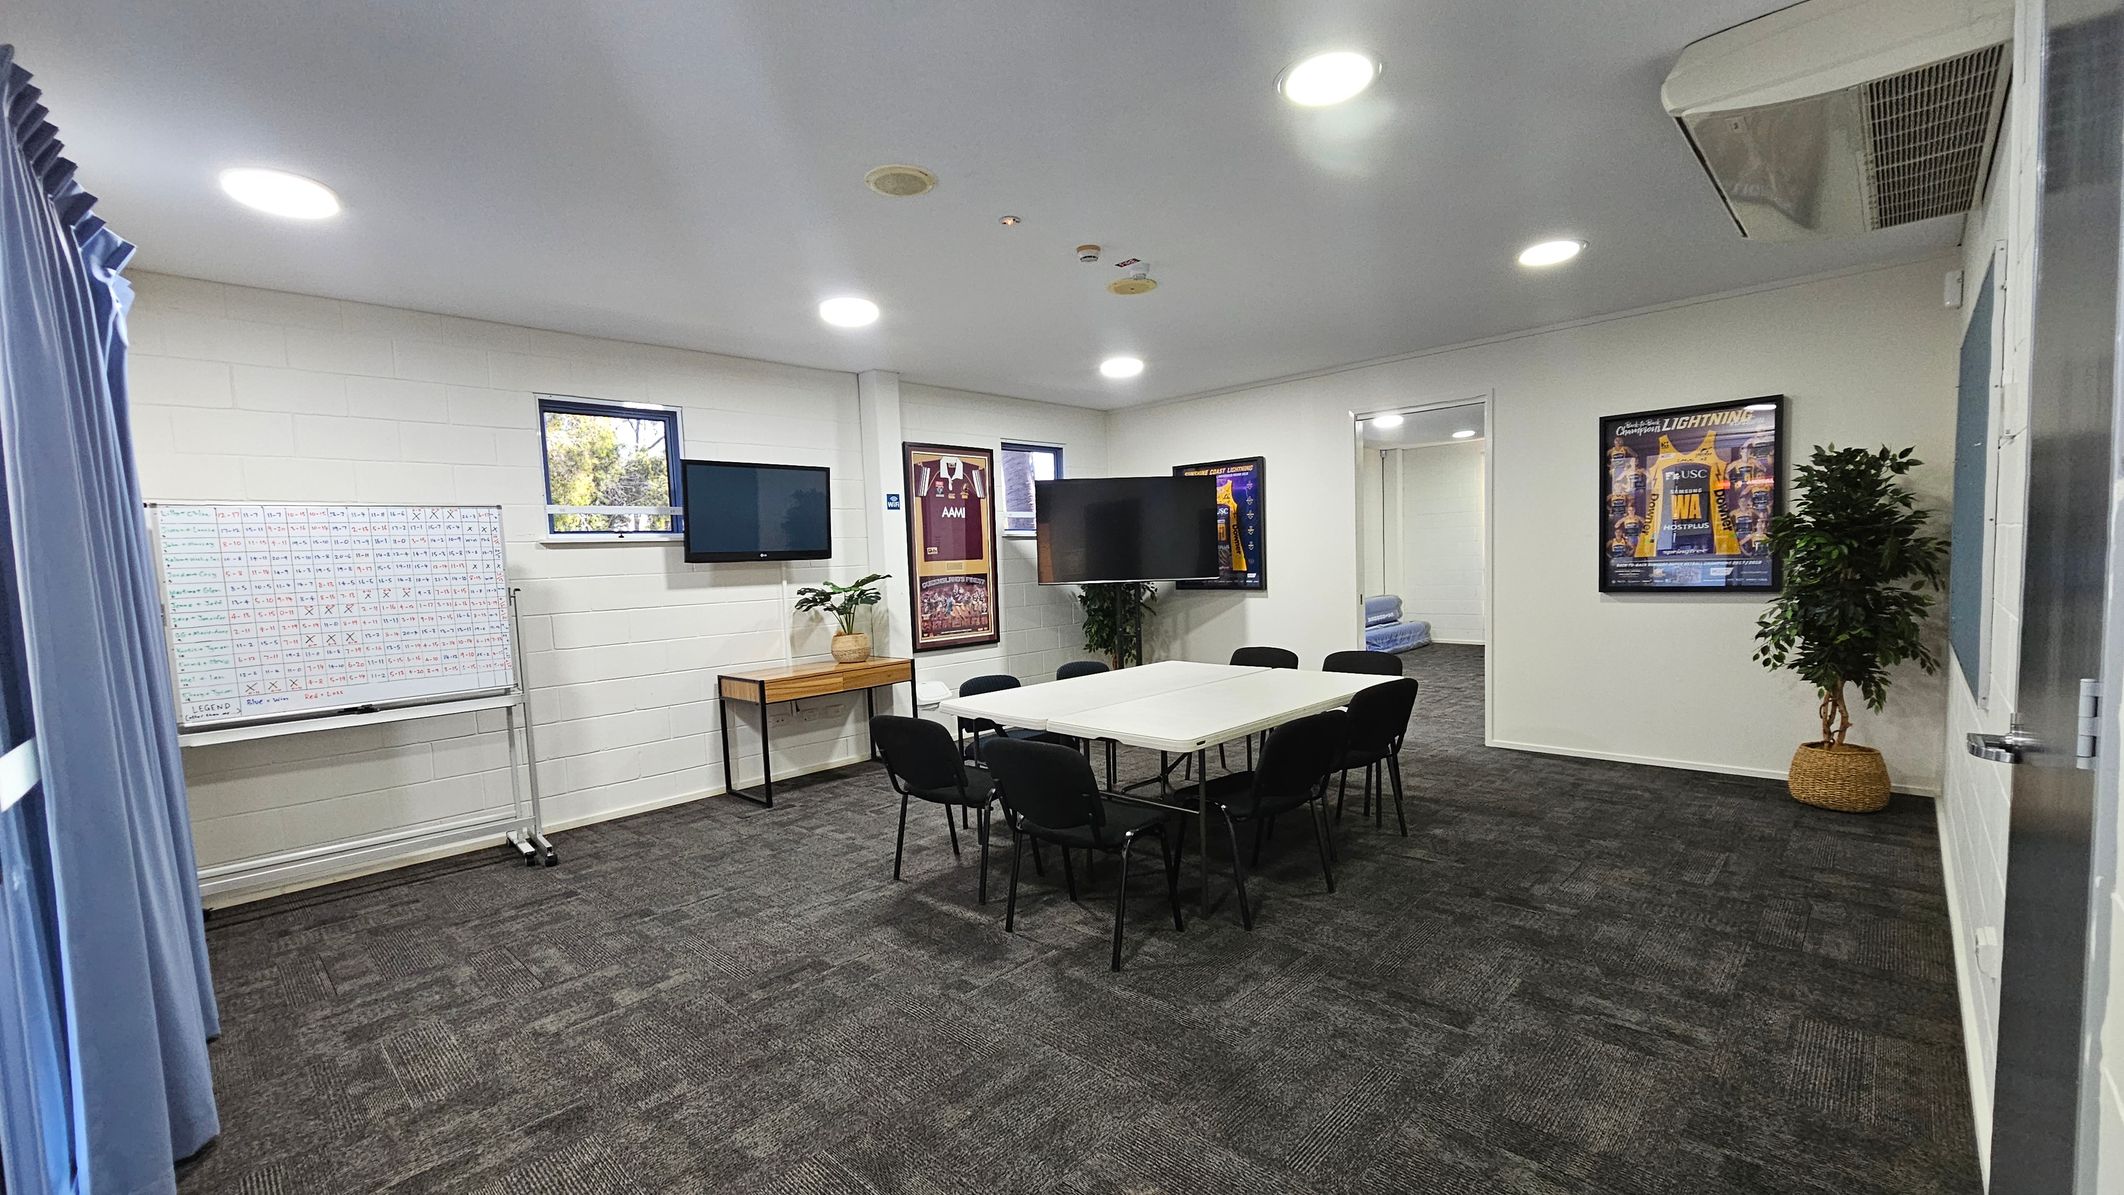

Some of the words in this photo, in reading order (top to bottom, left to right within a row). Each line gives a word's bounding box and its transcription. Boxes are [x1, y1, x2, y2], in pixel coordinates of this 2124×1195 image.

[1661, 409, 1754, 432] LIGHTNING
[1616, 424, 1661, 437] Champions
[1209, 468, 1226, 476] COAST
[1681, 469, 1708, 479] USC
[942, 506, 966, 519] AAMI
[1671, 494, 1702, 520] WA
[1714, 489, 1733, 532] Downer
[1642, 493, 1659, 536] Downer
[1663, 522, 1710, 531] HOSTPLUS
[192, 702, 231, 714] LEGEND
